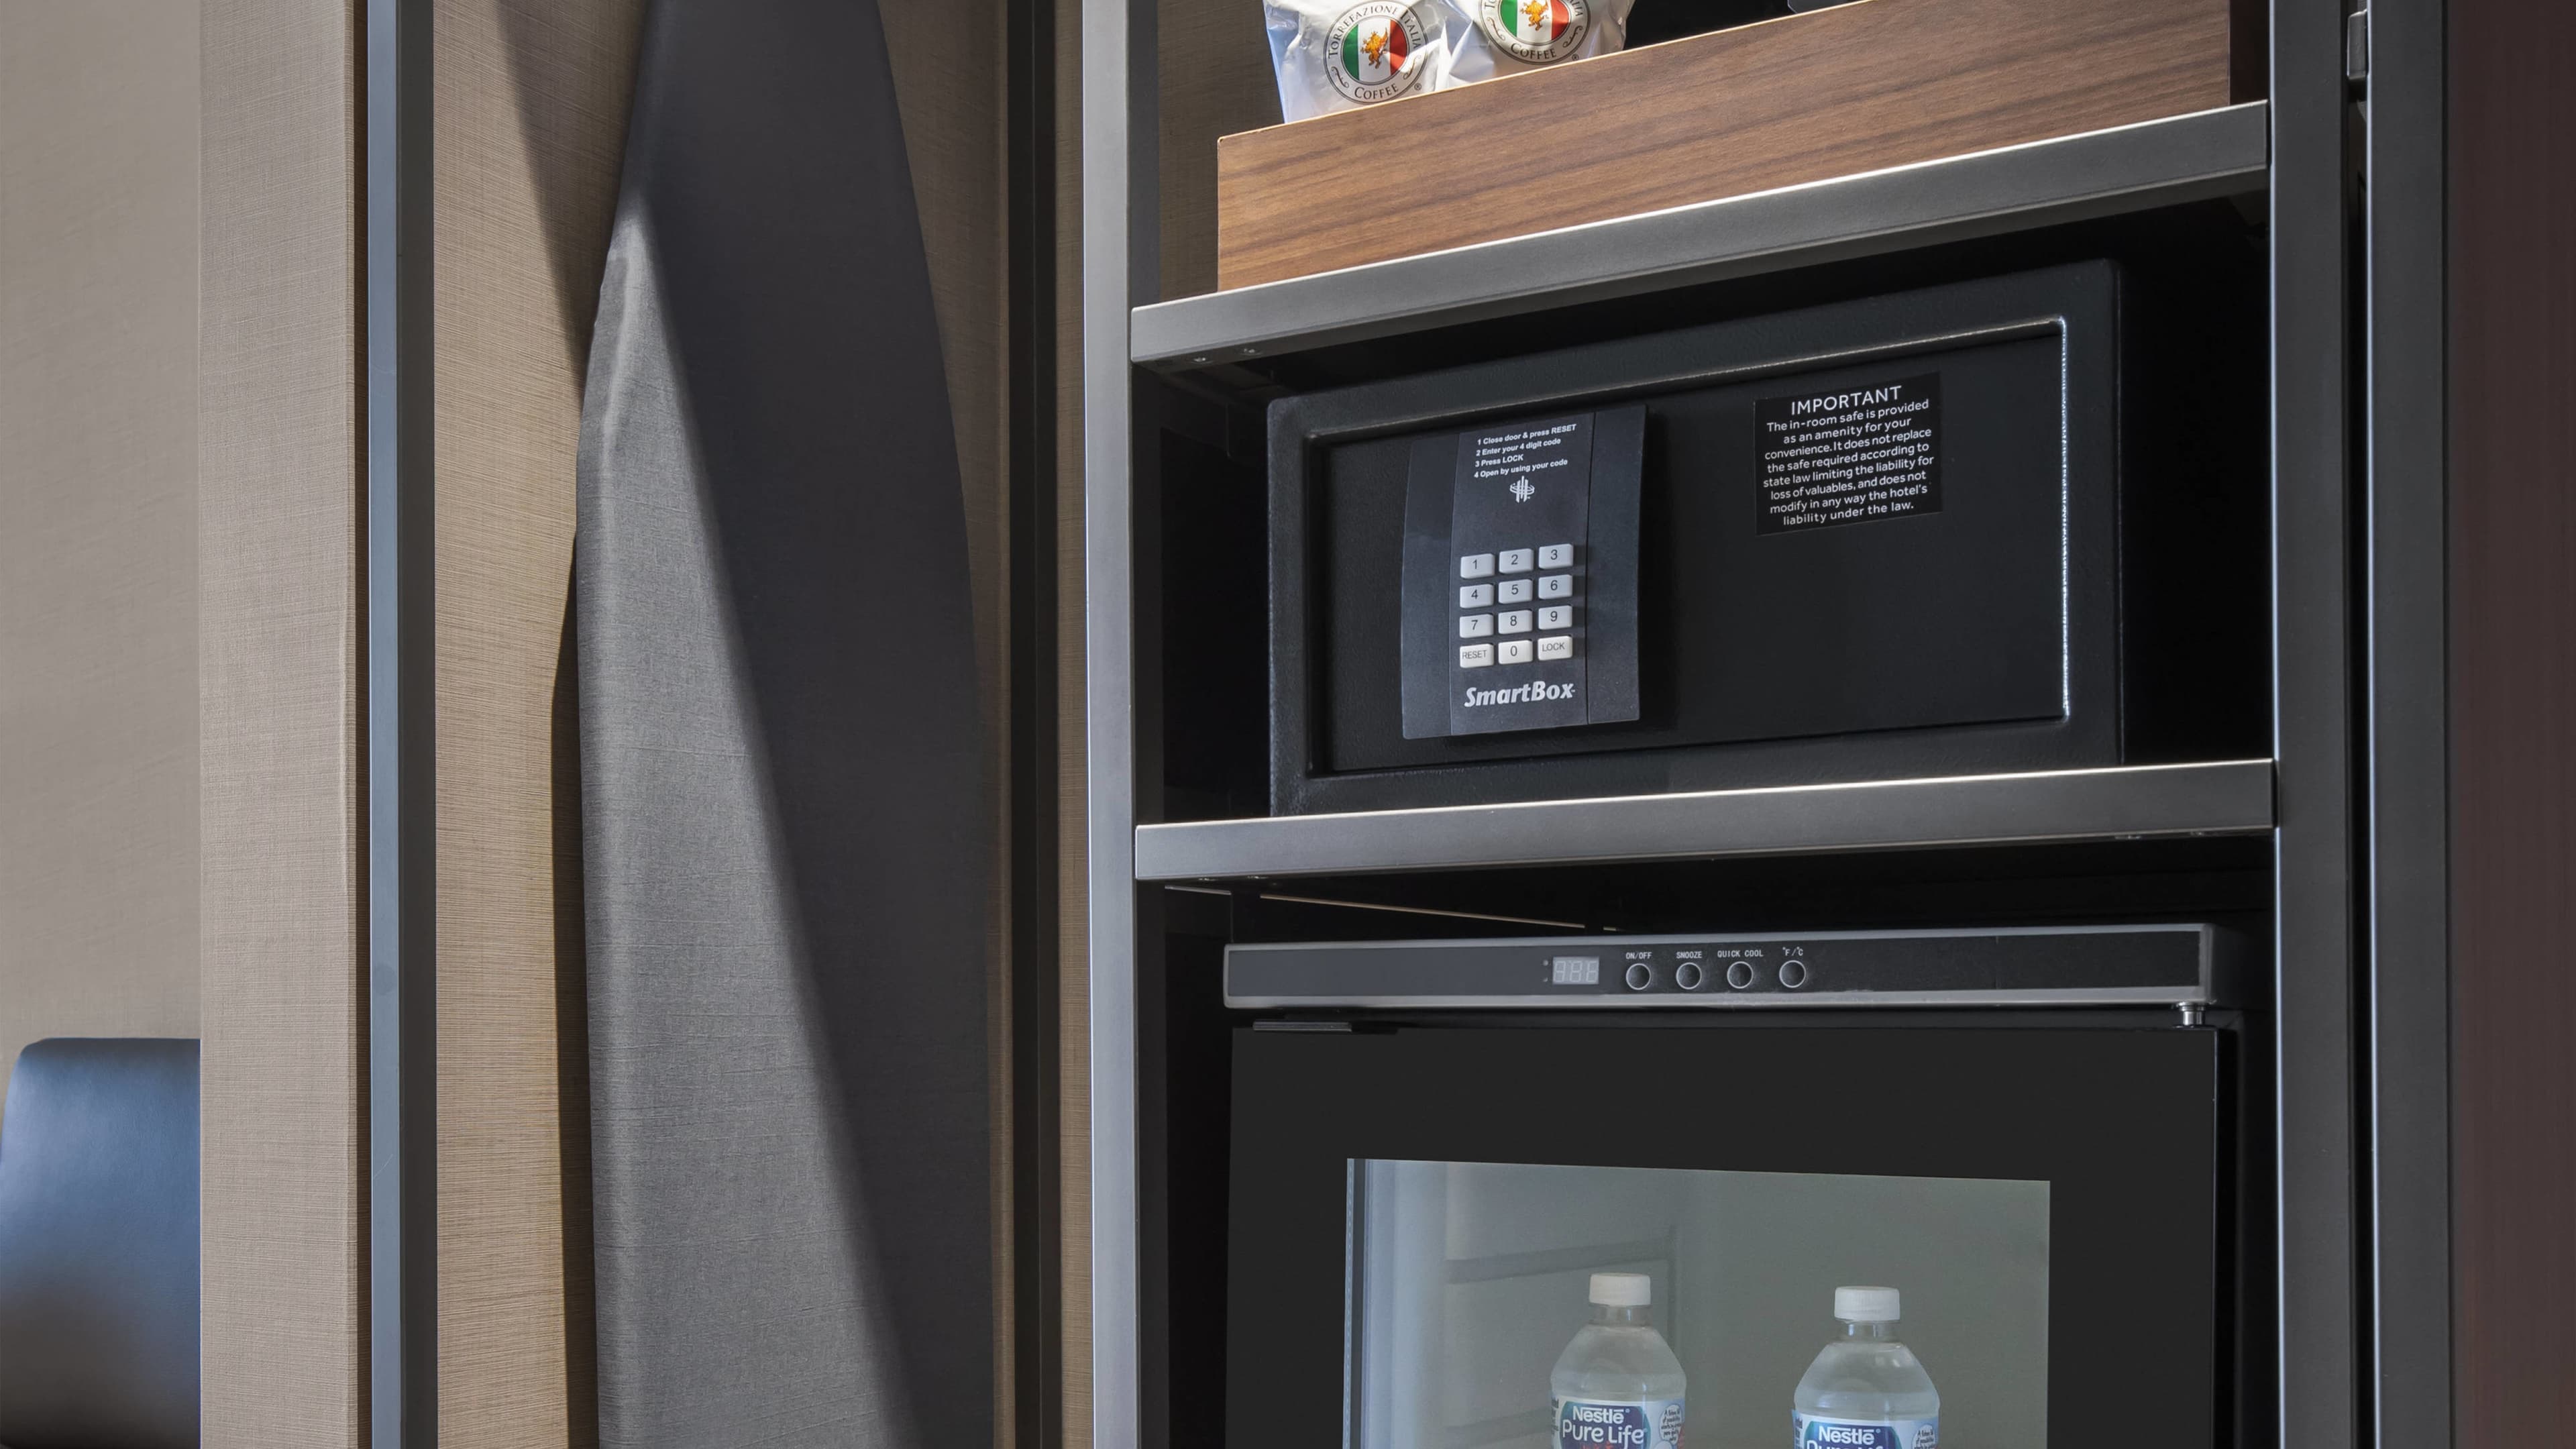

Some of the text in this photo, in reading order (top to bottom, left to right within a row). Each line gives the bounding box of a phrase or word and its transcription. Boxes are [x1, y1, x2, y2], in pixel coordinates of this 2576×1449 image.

[1400, 10, 1422, 49] ITALIA
[1511, 43, 1556, 60] COFFEE
[1354, 83, 1399, 100] COFFEE
[1792, 385, 1902, 415] IMPORTANT
[1767, 398, 1929, 432] The in-room safe is provided
[1483, 437, 1503, 445] Close
[1529, 429, 1550, 439] press
[1551, 423, 1576, 434] RESET
[1784, 418, 1911, 444] as an amenity for your
[1843, 439, 1870, 449] does
[1872, 434, 1890, 445] not
[1892, 429, 1931, 443] replace
[1482, 447, 1501, 455] Enter
[1502, 445, 1519, 454] your
[1525, 441, 1542, 449] digit
[1543, 438, 1561, 446] code
[1480, 470, 1499, 478] Open
[1500, 468, 1509, 476] by
[1511, 465, 1531, 473] using
[1532, 462, 1549, 472] your
[1550, 458, 1568, 468] code
[1481, 458, 1501, 466] Press
[1502, 453, 1523, 464] LOCK
[1768, 443, 1929, 473] the safe required according to
[1764, 455, 1934, 488] state law limiting the liability for
[1771, 470, 1926, 500] loss of valuables, and does not
[1770, 484, 1927, 513] modify in any way the hotel's
[1784, 502, 1914, 525] liability under the law.
[1472, 549, 1558, 570] 1 2 3
[1470, 580, 1558, 600] 4 5 6
[1471, 610, 1558, 631] 7 8 9
[1462, 642, 1565, 659] RESET 0 LOCK
[1464, 681, 1574, 707] SmartBox
[1744, 949, 1764, 957] COOL
[1562, 1419, 1644, 1449] Pure Life
